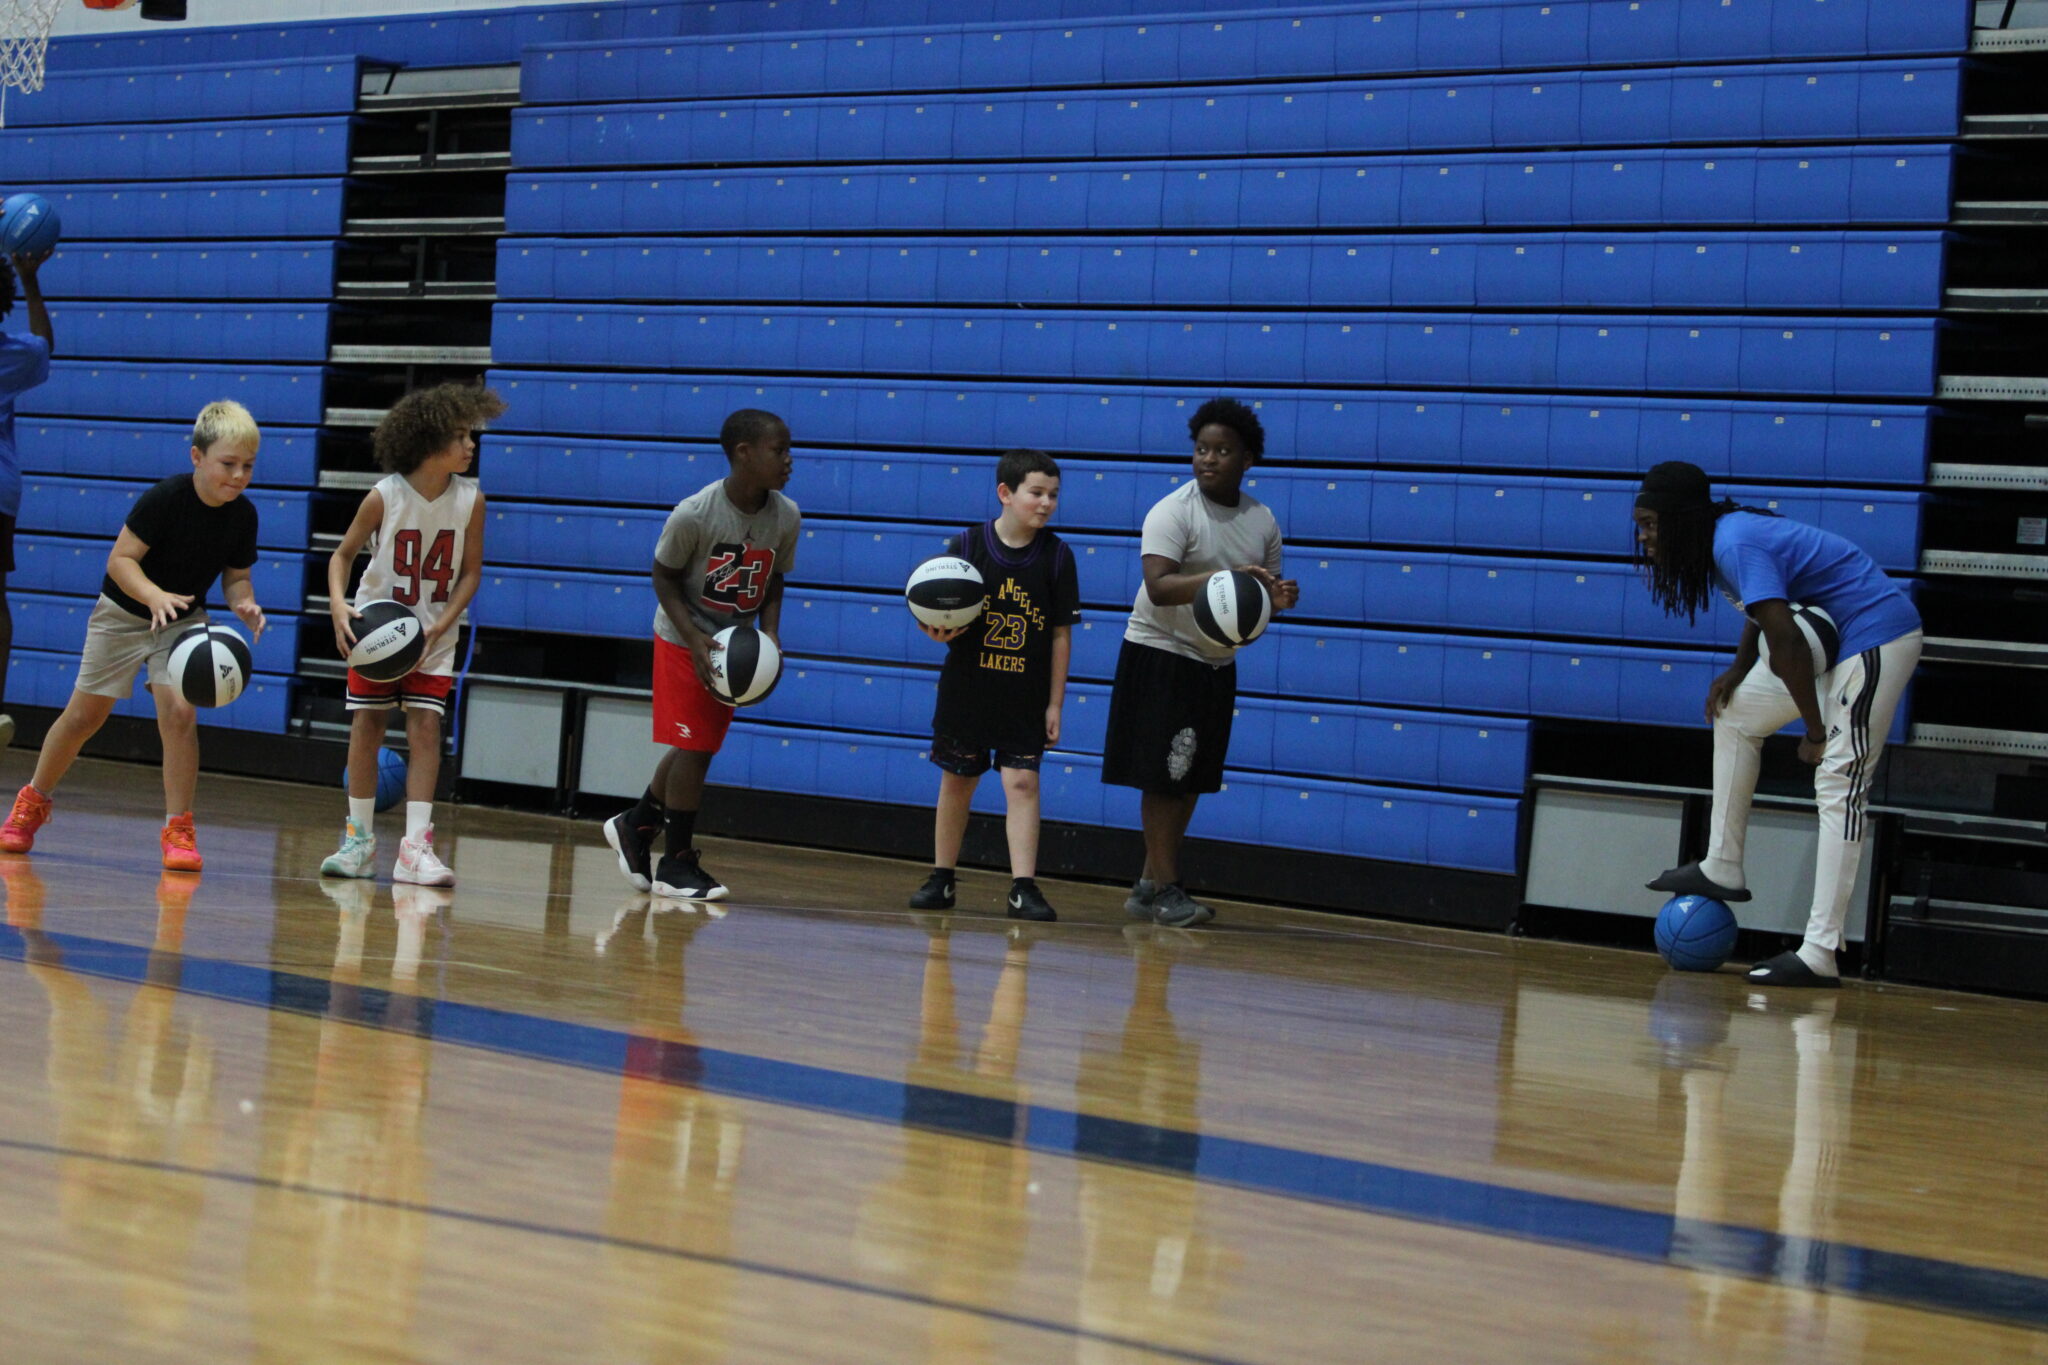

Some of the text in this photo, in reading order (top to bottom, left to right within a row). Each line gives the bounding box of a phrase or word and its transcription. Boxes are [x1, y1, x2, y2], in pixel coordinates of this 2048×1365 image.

[392, 529, 455, 606] 94
[702, 542, 776, 613] 23
[998, 577, 1045, 631] ANGELES
[366, 634, 397, 655] STERLING
[983, 611, 1027, 650] 23
[979, 652, 1026, 673] LAKERS
